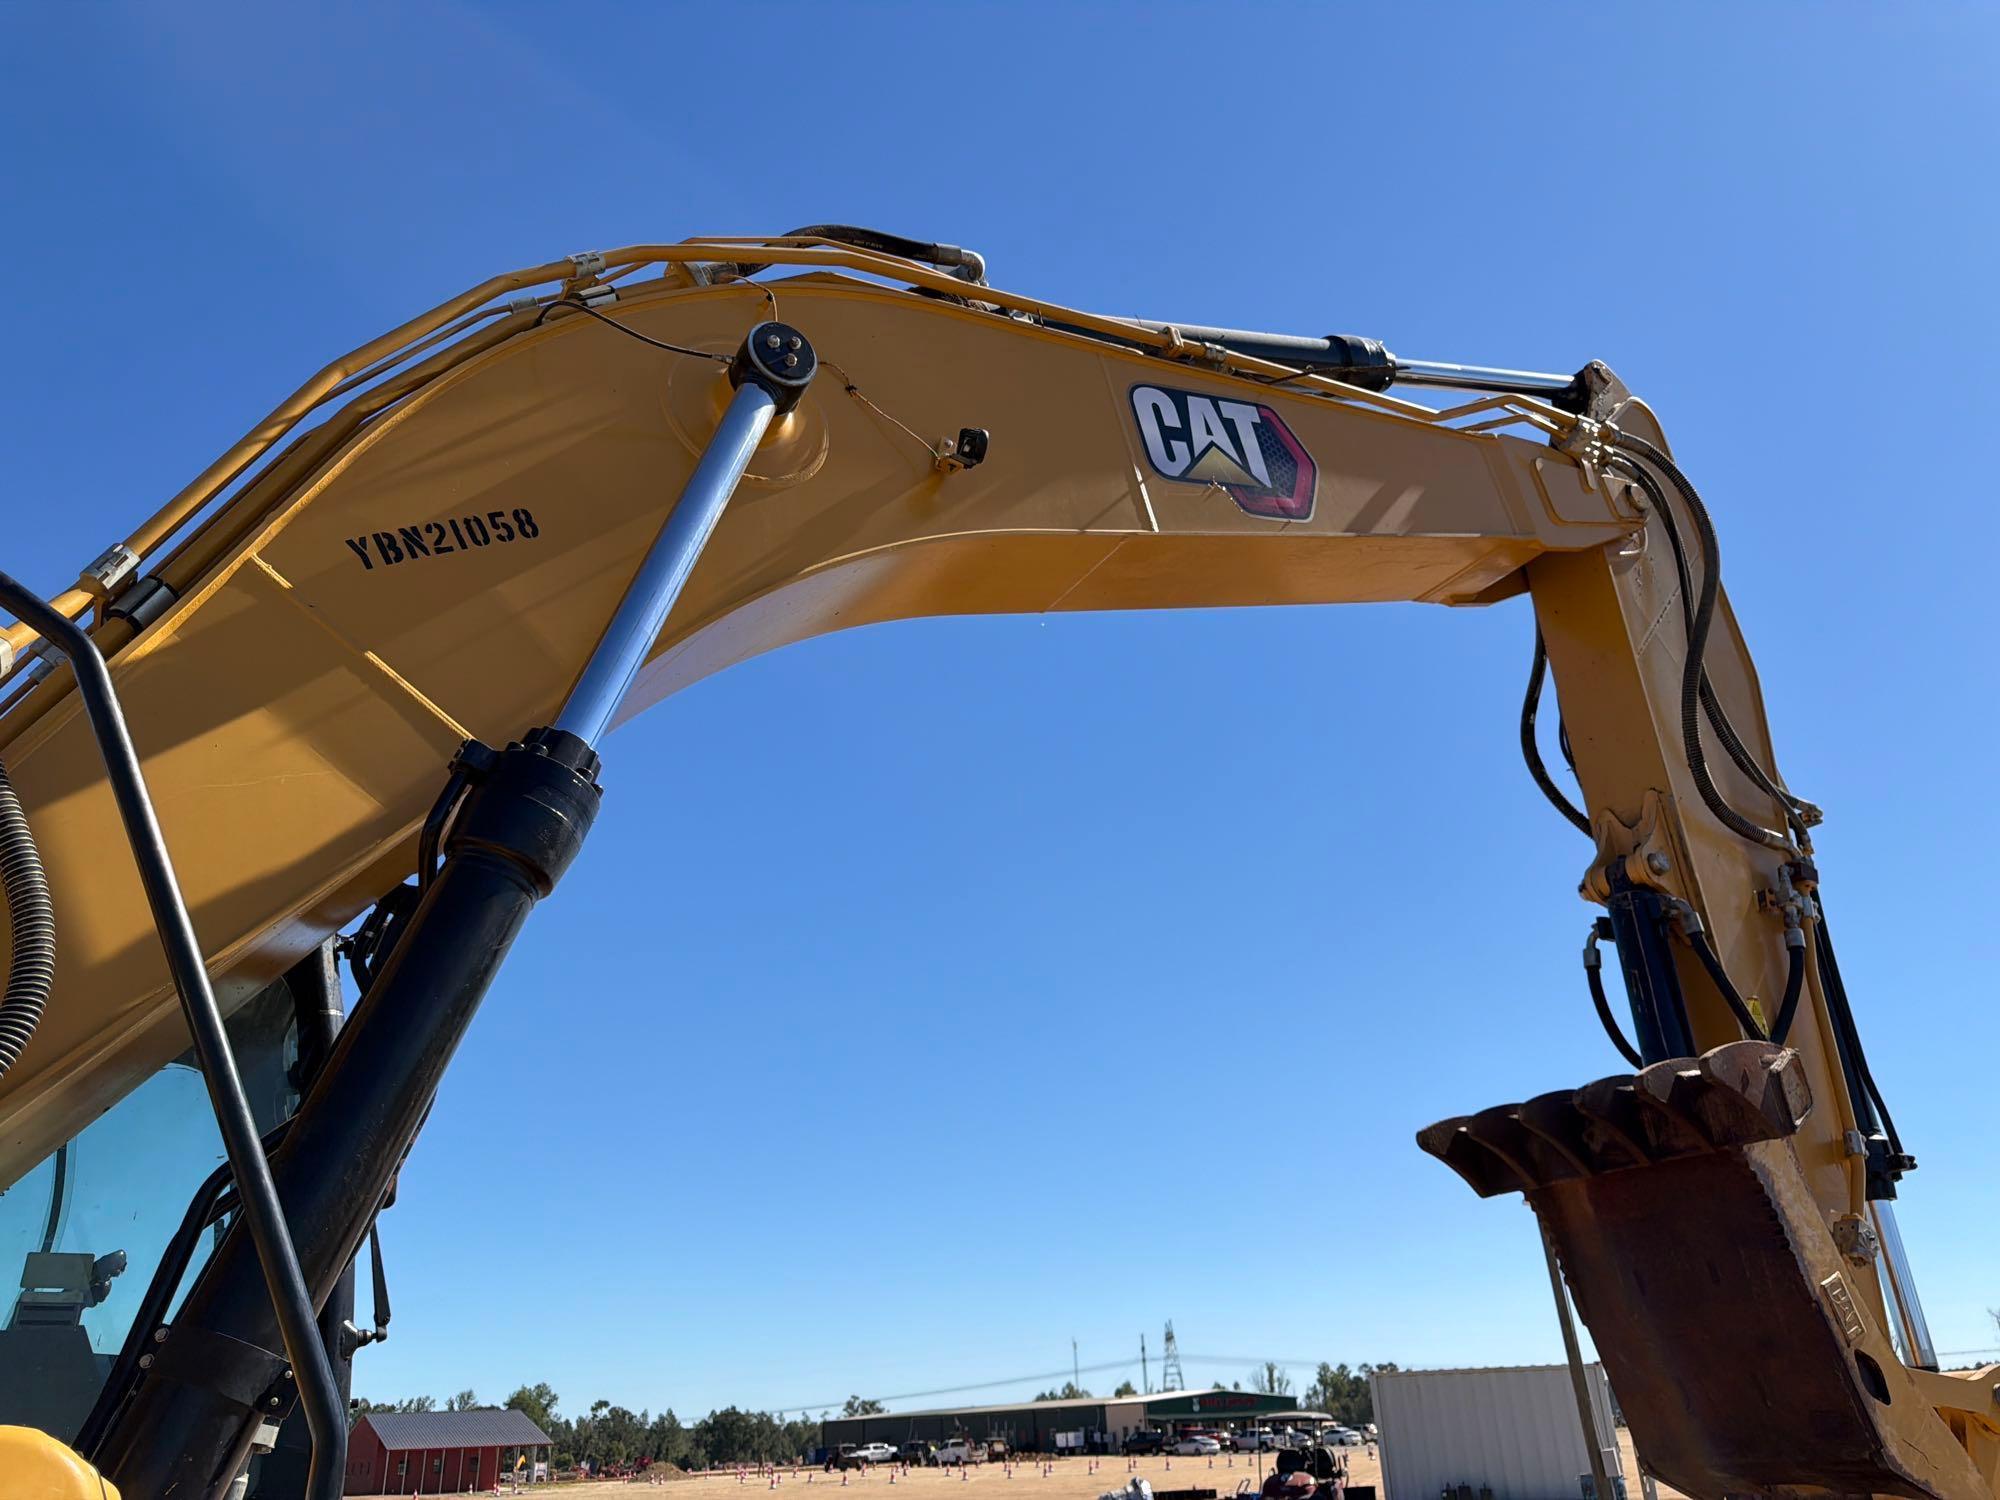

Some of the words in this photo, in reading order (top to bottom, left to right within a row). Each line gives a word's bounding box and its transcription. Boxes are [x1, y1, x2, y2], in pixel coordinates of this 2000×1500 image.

[1132, 386, 1272, 489] CAT
[345, 508, 540, 570] YBN21058
[1824, 1278, 1864, 1340] CAT
